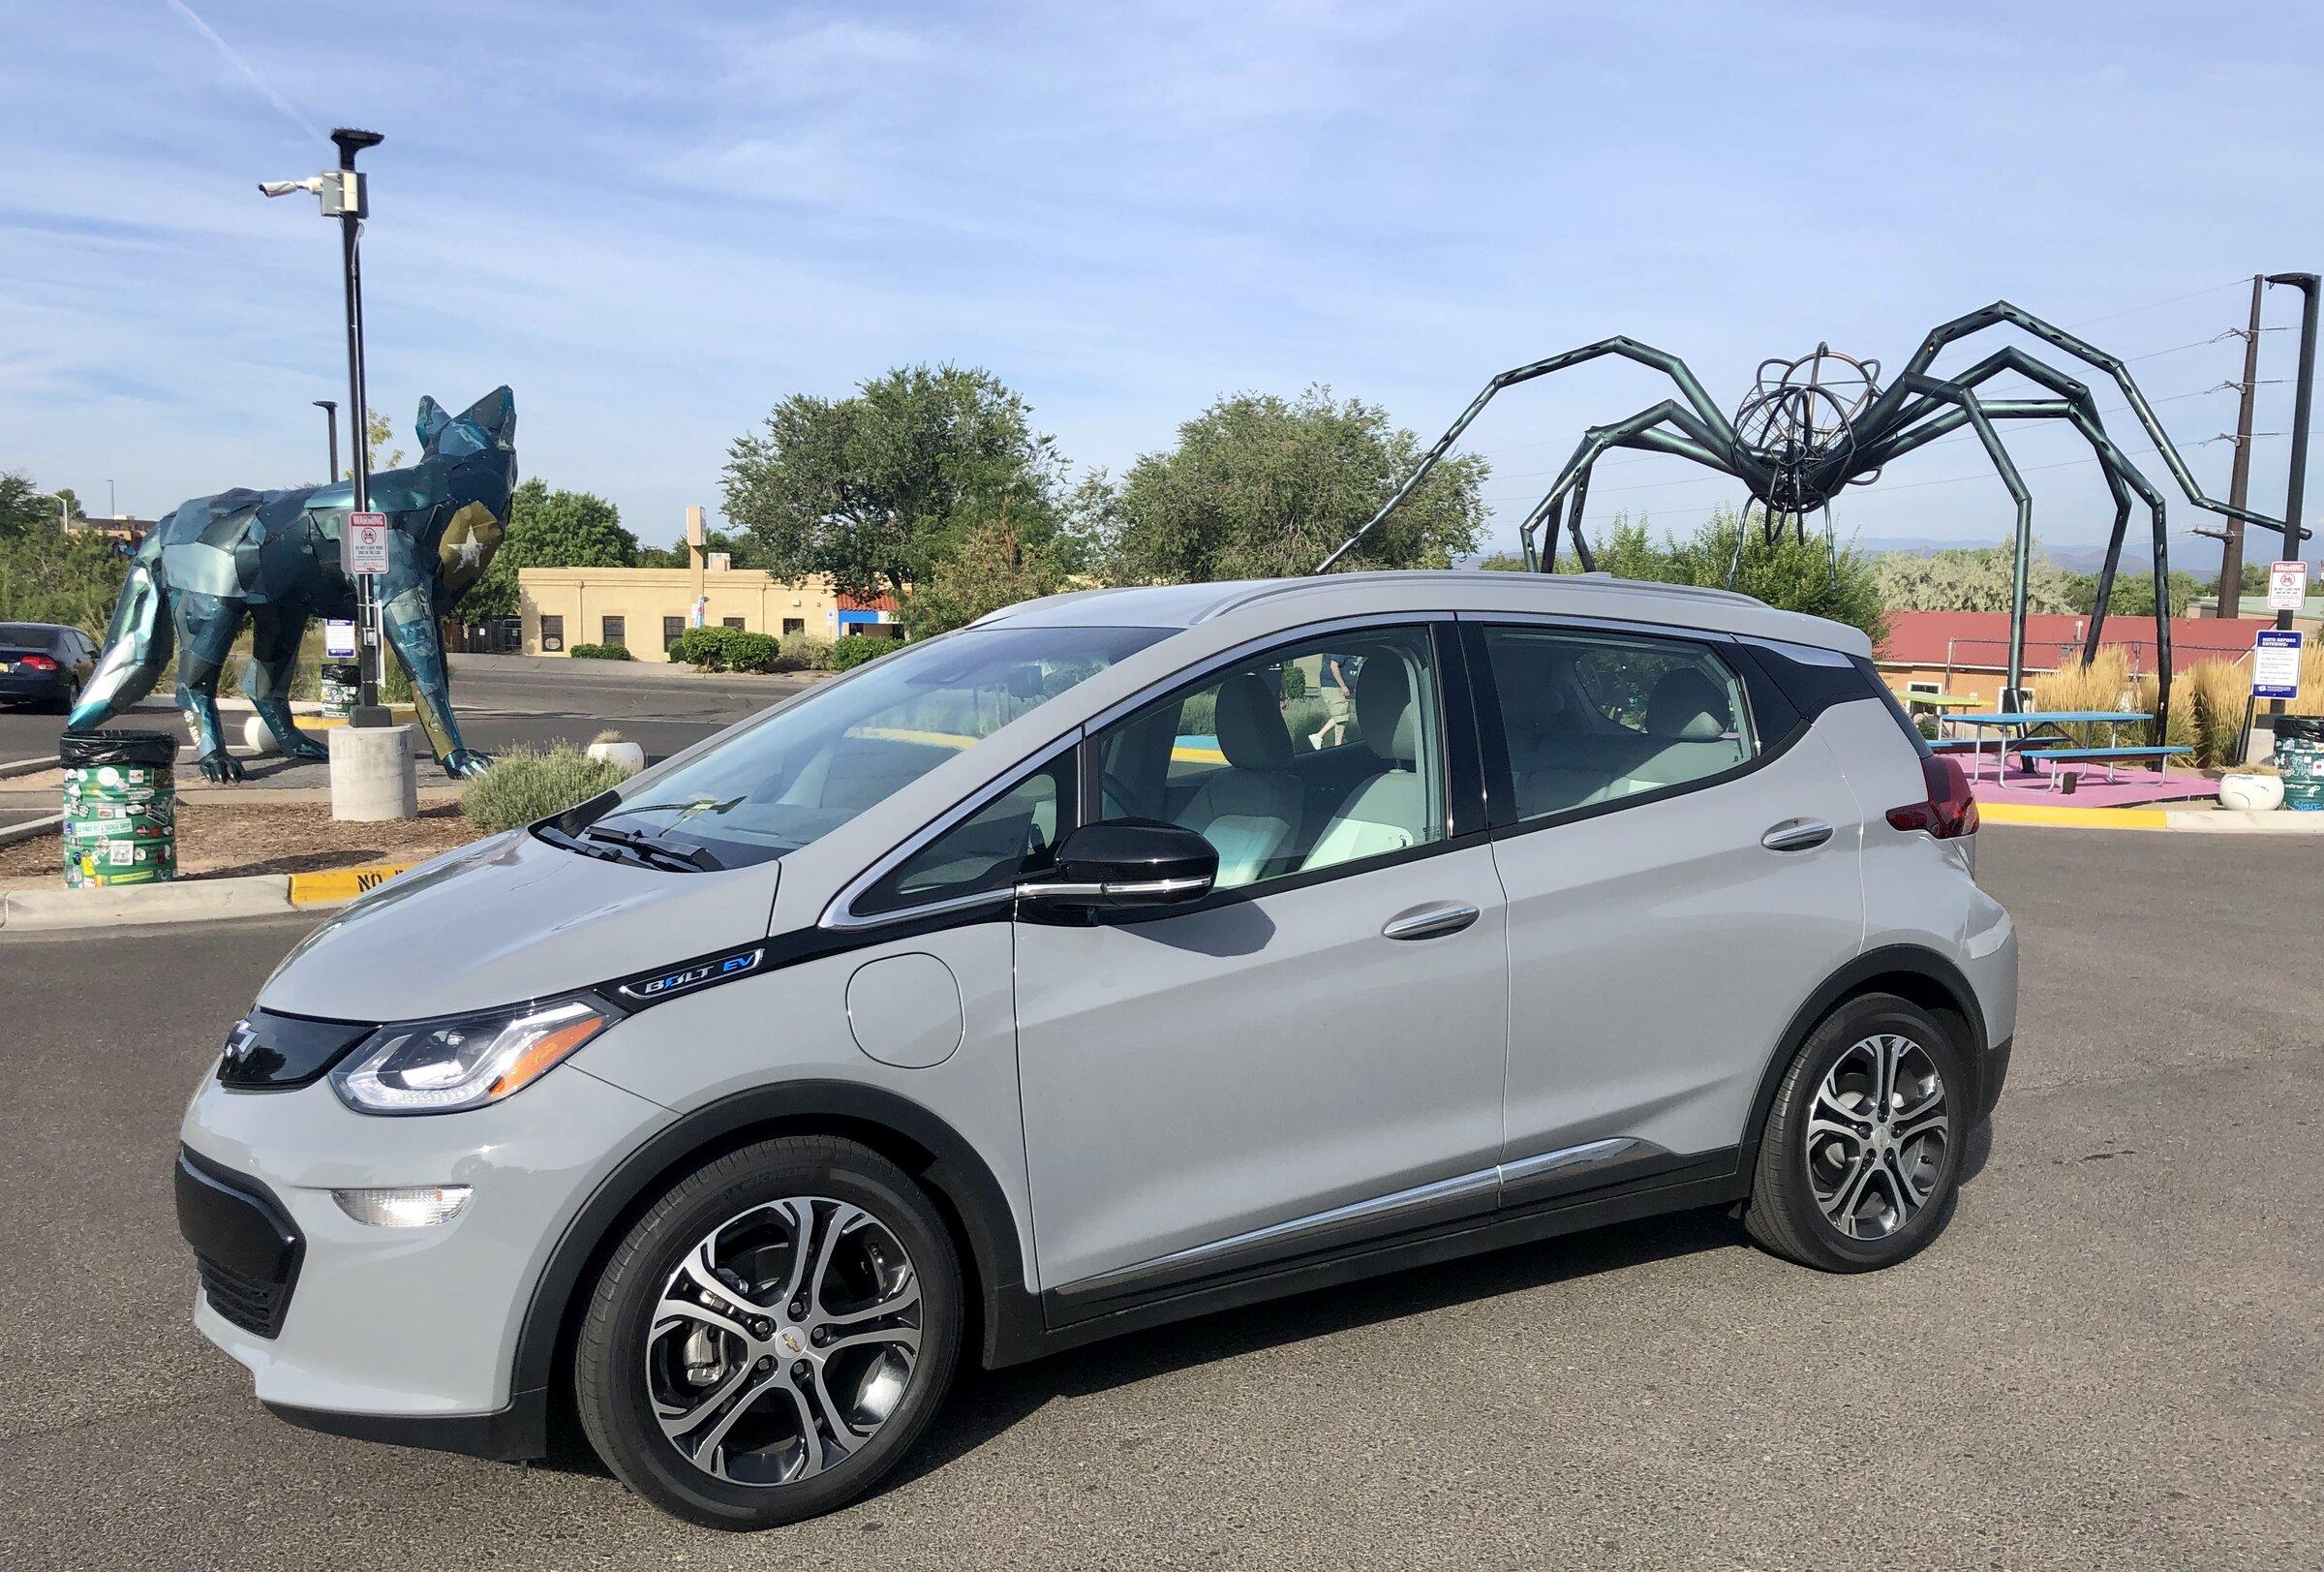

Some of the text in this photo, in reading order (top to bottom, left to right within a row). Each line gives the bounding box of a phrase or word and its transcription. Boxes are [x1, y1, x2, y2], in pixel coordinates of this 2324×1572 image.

[352, 515, 383, 525] WARNING
[357, 874, 382, 892] NO
[645, 954, 754, 994] BOLT EV
